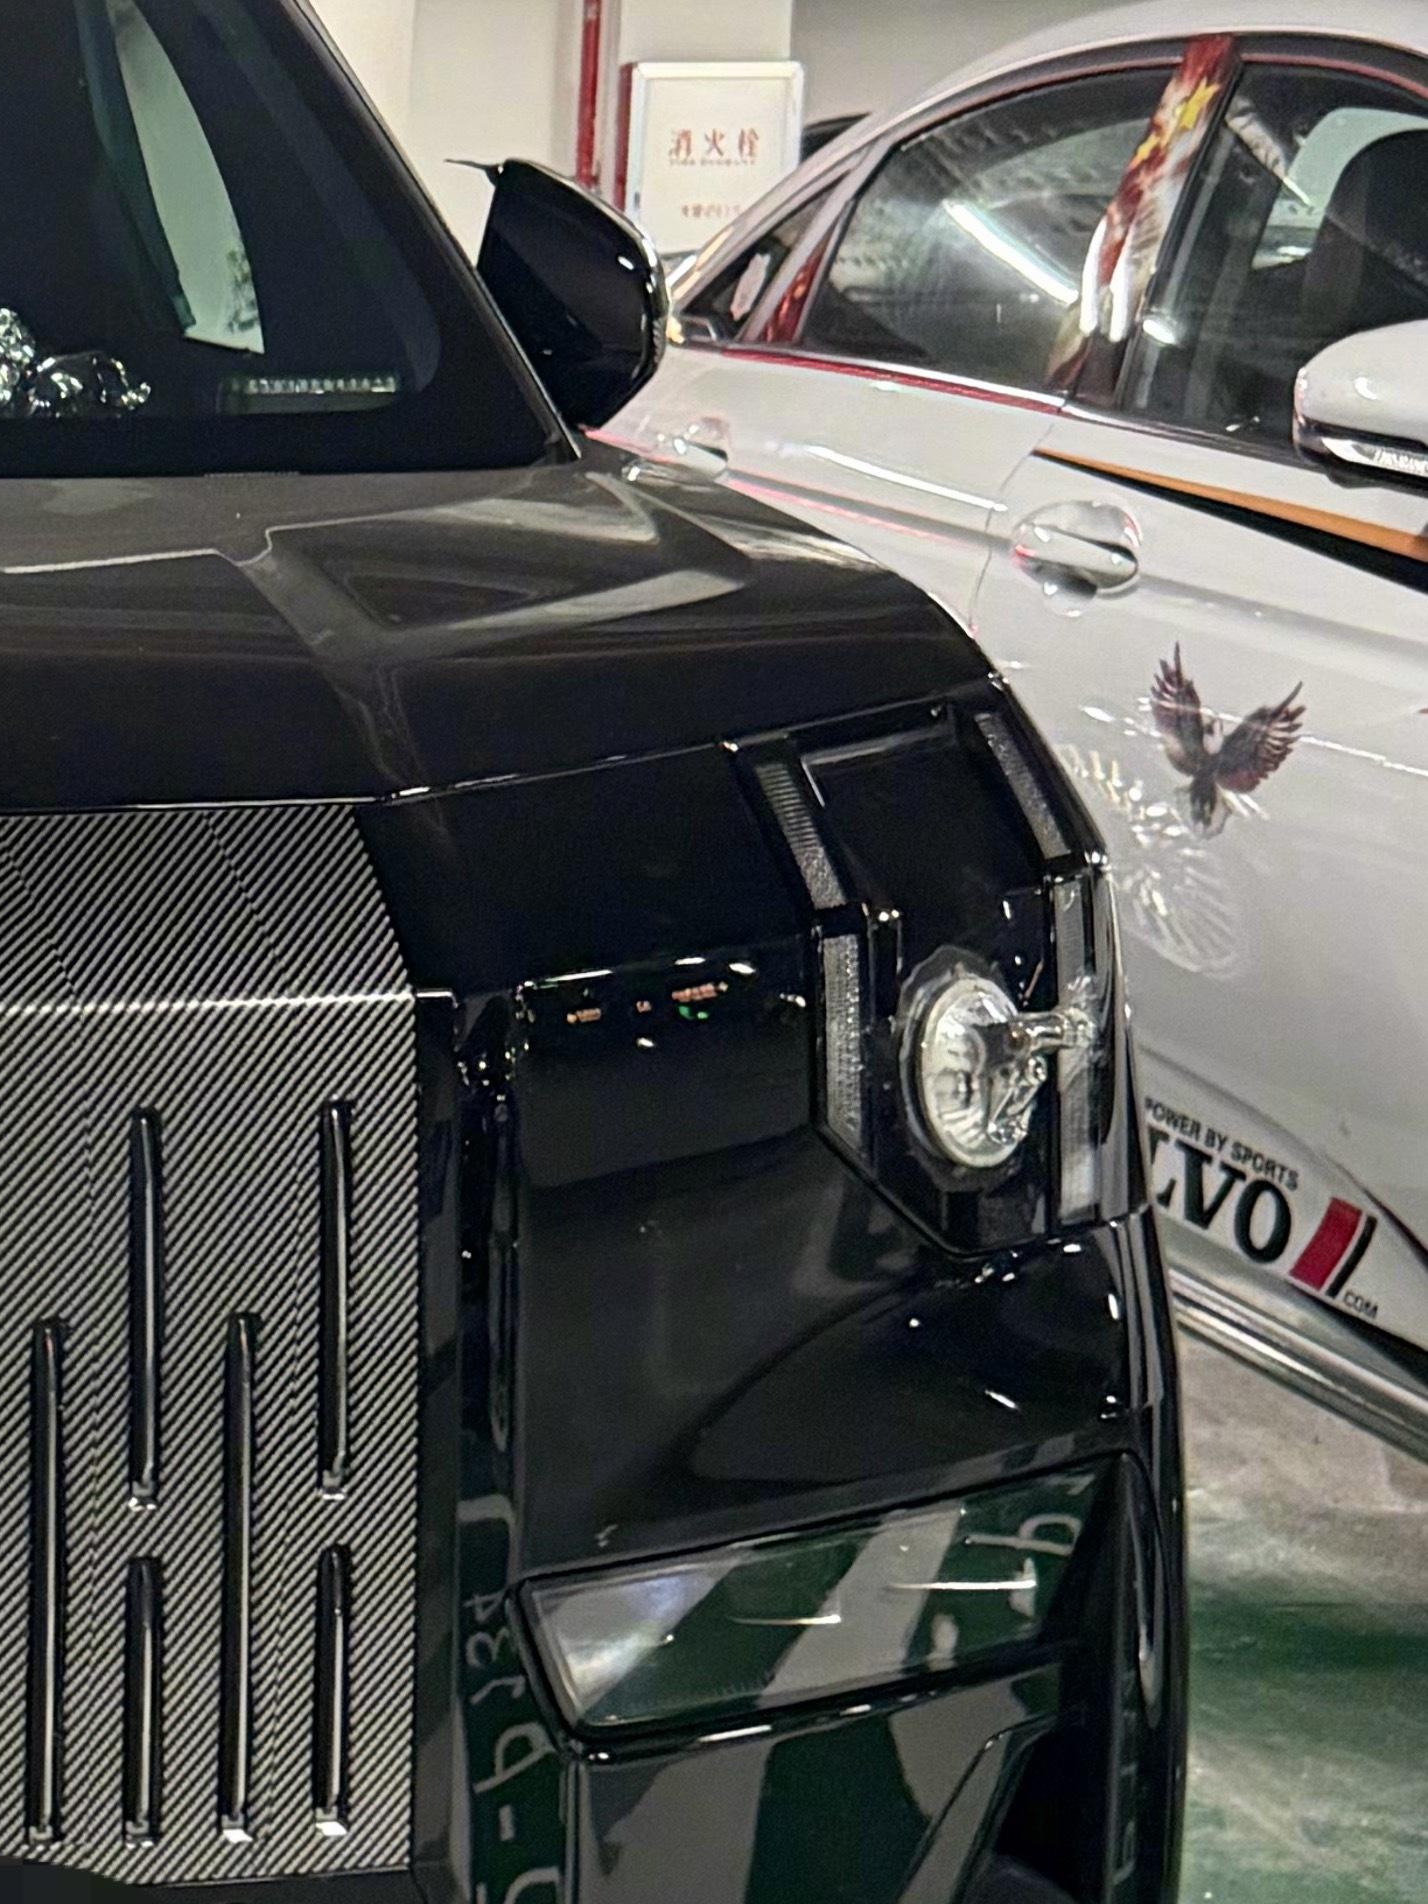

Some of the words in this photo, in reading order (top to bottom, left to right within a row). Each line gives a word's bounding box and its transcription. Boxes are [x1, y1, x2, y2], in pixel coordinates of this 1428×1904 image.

[669, 128, 759, 158] 消火栓
[1205, 1123, 1228, 1152] BY
[1230, 1141, 1300, 1192] SPORTS
